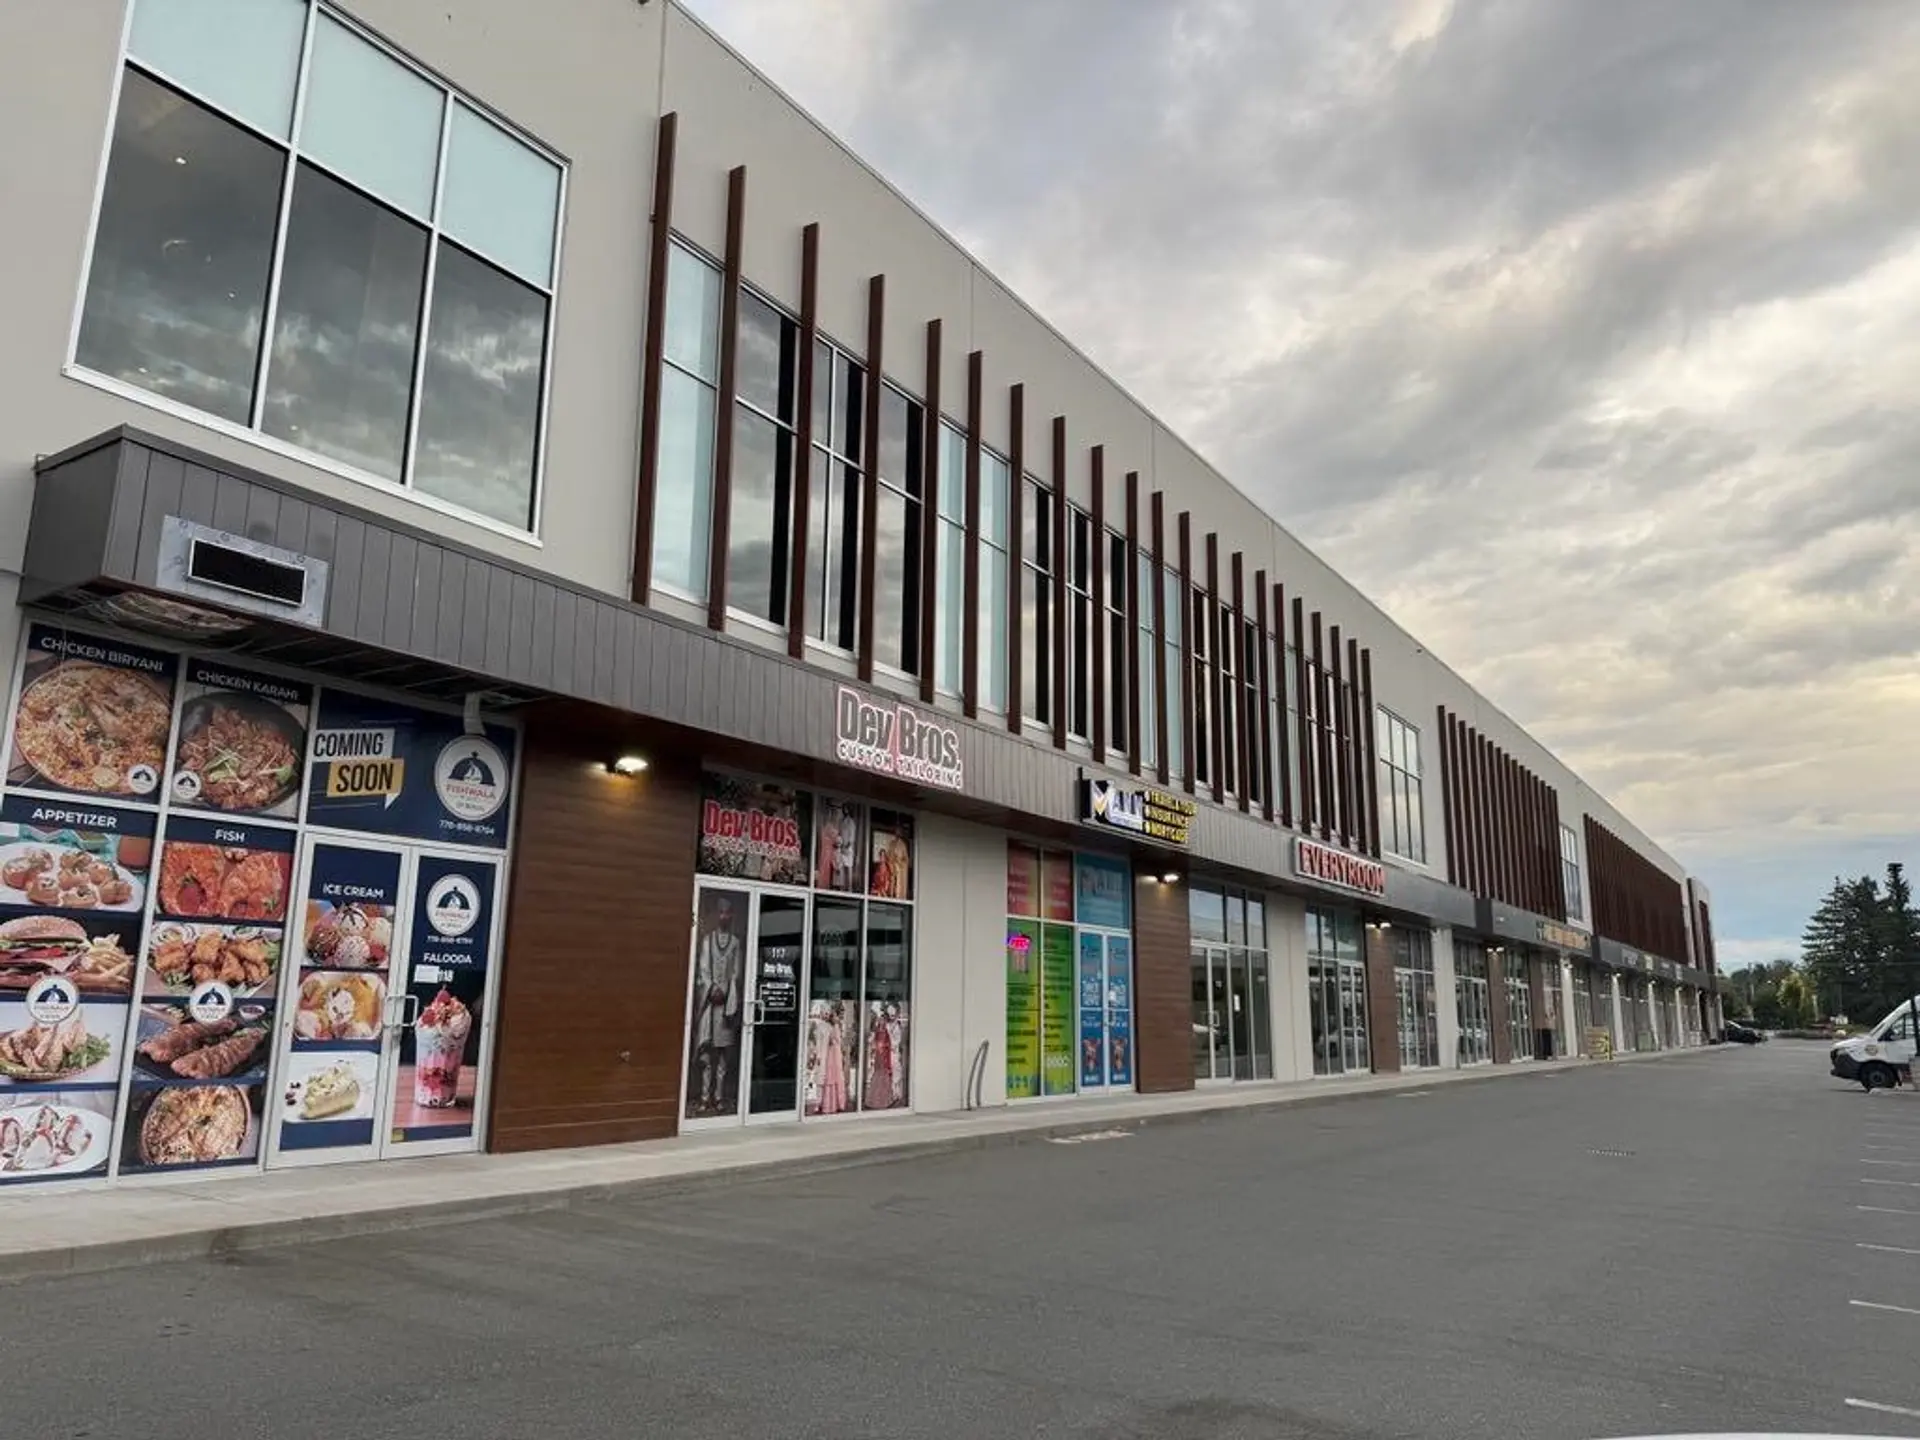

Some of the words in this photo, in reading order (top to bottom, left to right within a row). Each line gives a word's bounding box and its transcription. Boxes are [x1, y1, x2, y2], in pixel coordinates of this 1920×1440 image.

[41, 636, 105, 661] CHICKEN
[108, 652, 164, 672] BIRYANI
[196, 669, 251, 691] CHICKEN
[253, 682, 299, 700] KARAHI
[837, 686, 895, 751] Dev
[313, 732, 384, 758] COMING
[336, 763, 394, 793] SOON
[837, 741, 895, 772] CUSTOM
[896, 758, 963, 790] TAILORING
[32, 807, 118, 829] APPETIZER
[703, 800, 747, 838] Dev
[215, 828, 245, 844] FISH
[322, 883, 341, 896] ICE
[343, 885, 384, 899] CREAM
[423, 952, 473, 965] FALOODA
